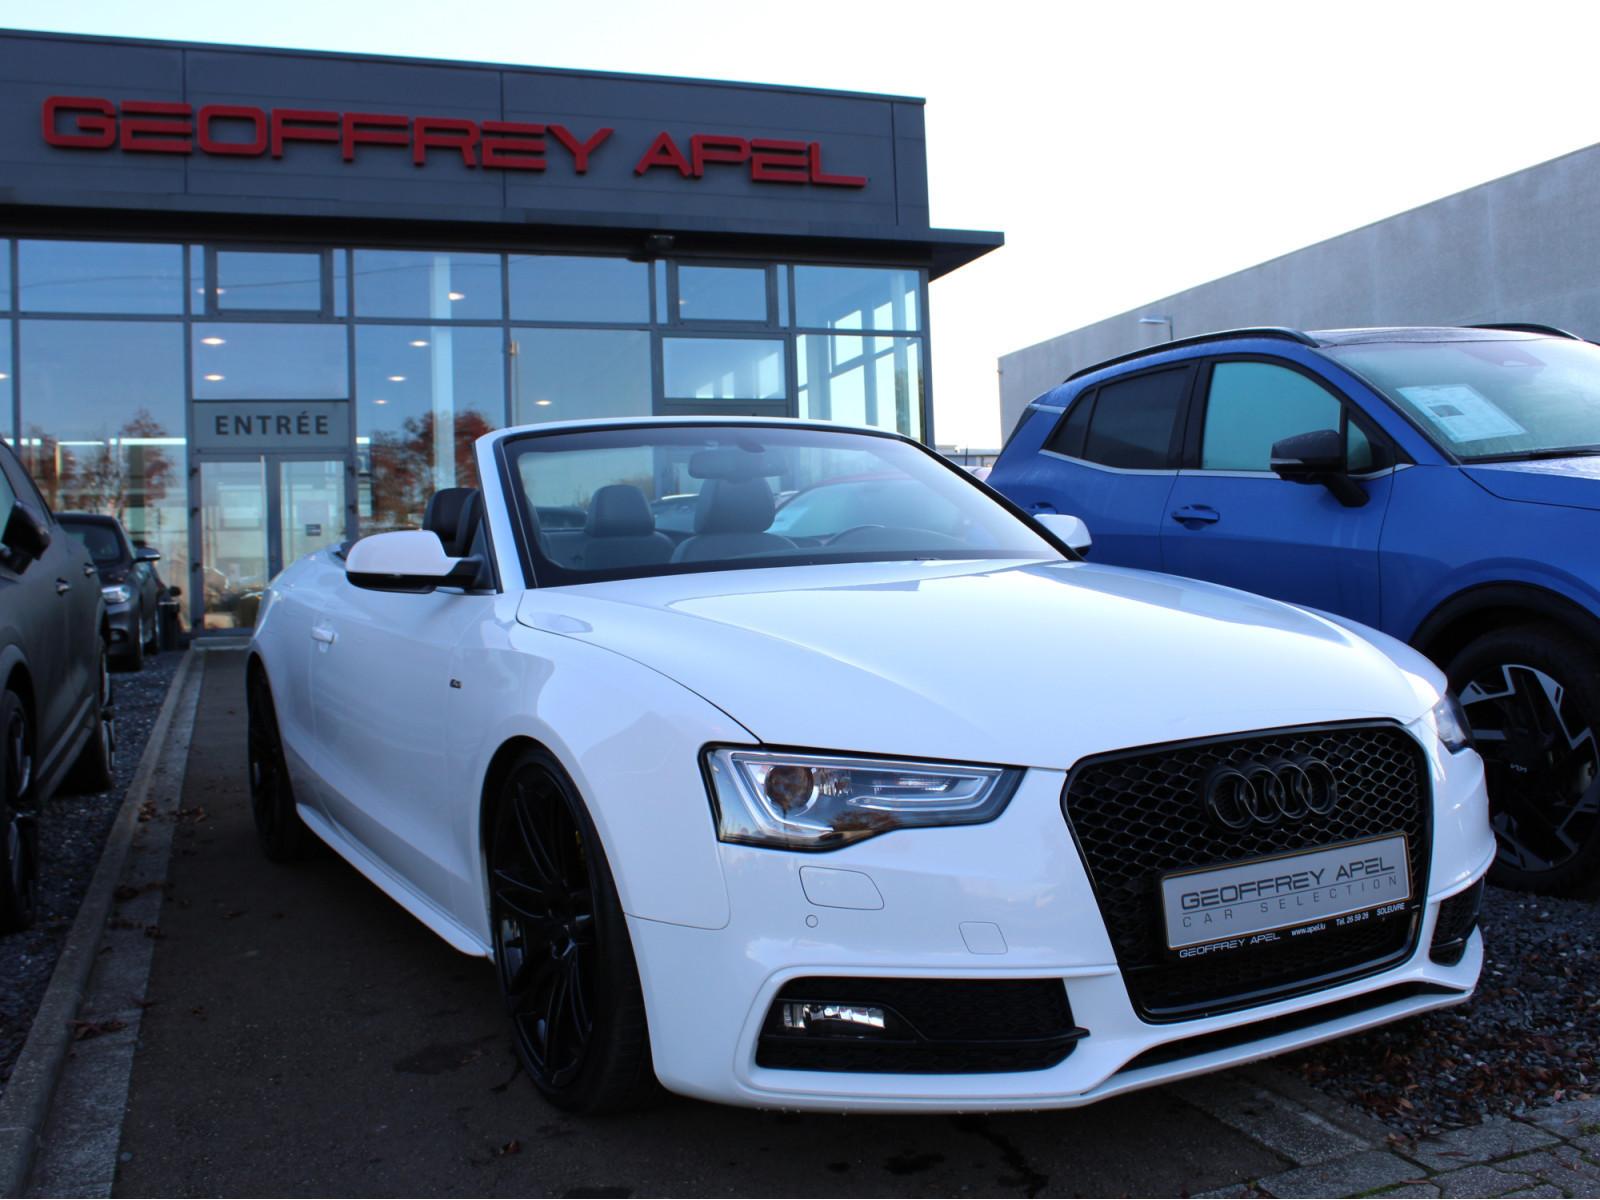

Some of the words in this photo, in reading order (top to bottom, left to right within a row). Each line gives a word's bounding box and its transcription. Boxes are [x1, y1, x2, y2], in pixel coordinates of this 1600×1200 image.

[42, 95, 614, 174] GEOFFREY
[634, 131, 866, 187] APEL
[215, 411, 329, 436] ENTRÉE
[1181, 868, 1325, 910] GEOFFREY
[1335, 857, 1395, 881] APEL
[1182, 908, 1233, 928] CAR
[1260, 874, 1398, 913] SELECTION
[1179, 938, 1246, 959] GEOFFREY
[1250, 932, 1281, 945] APEL
